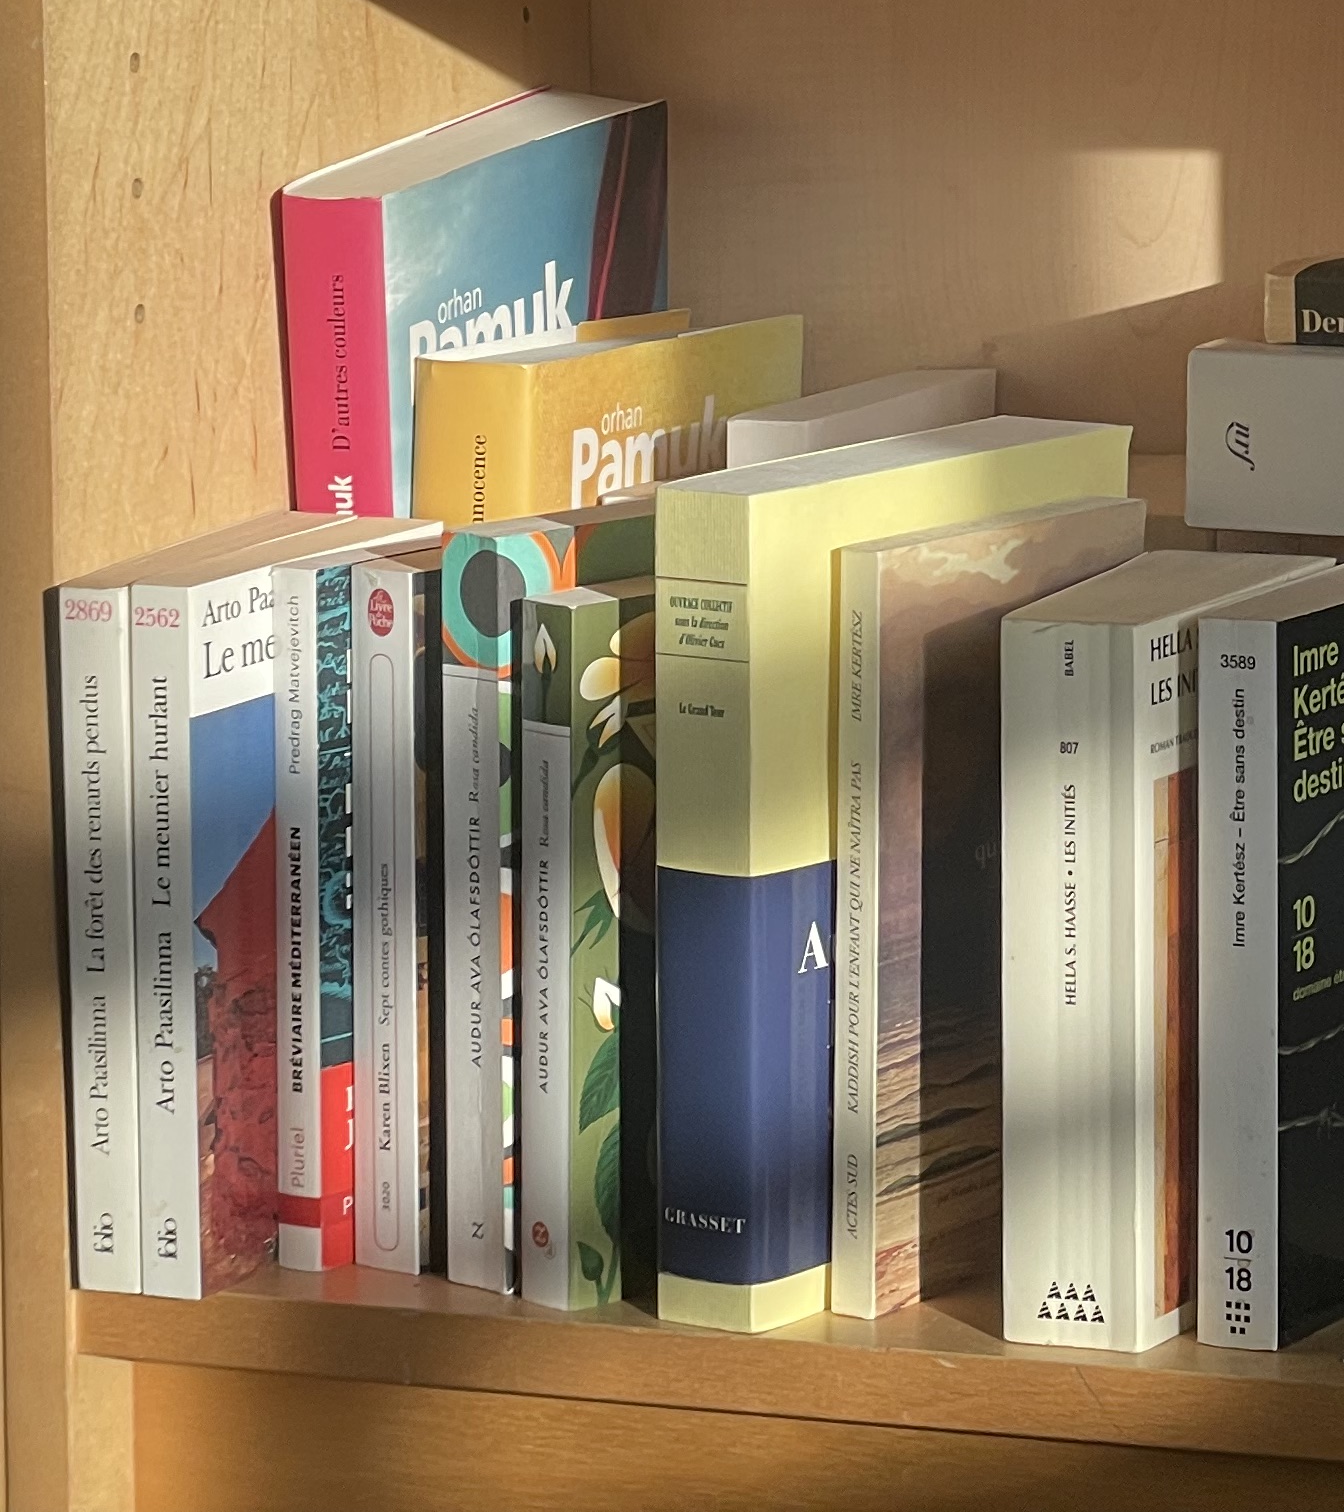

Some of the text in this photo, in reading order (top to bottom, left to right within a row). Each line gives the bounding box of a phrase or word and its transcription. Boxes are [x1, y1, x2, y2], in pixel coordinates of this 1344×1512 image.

[437, 287, 482, 324] orhan
[601, 403, 643, 436] orhan
[572, 395, 727, 509] Pamuk
[64, 600, 112, 621] 2869
[135, 608, 180, 627] 2562
[202, 600, 241, 627] Arto
[203, 641, 234, 679] Le
[1064, 640, 1074, 676] BABEL
[1220, 655, 1255, 670] 3589
[1292, 641, 1339, 676] Imre
[287, 595, 302, 774] Predrag Matvejevitch
[1293, 721, 1335, 761] Être
[149, 676, 174, 1114] Arto Paasilinna Le meunier hurlant
[1292, 895, 1316, 931] 10
[1293, 937, 1315, 973] 18
[90, 996, 109, 1156] Arto Paasilinna
[291, 1127, 306, 1188] Pluriel
[665, 1209, 746, 1234] GRASSET
[1225, 1229, 1253, 1254] 10
[1225, 1267, 1252, 1292] 18
